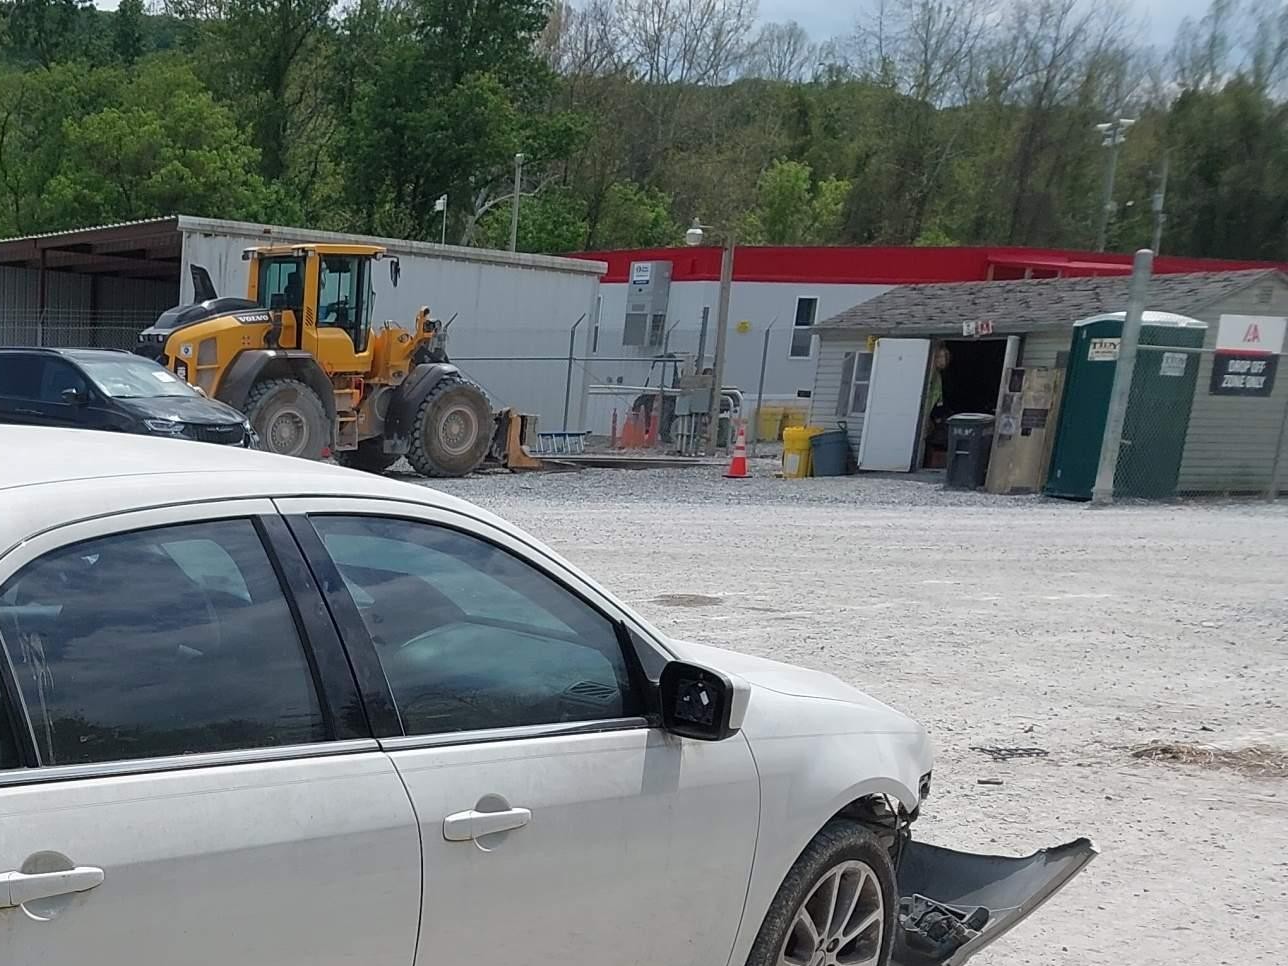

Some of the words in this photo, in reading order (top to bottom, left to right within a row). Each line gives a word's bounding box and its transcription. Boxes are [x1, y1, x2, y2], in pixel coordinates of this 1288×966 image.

[238, 314, 269, 322] VOLVO
[1251, 360, 1267, 373] OFF
[1221, 374, 1245, 387] ZONE
